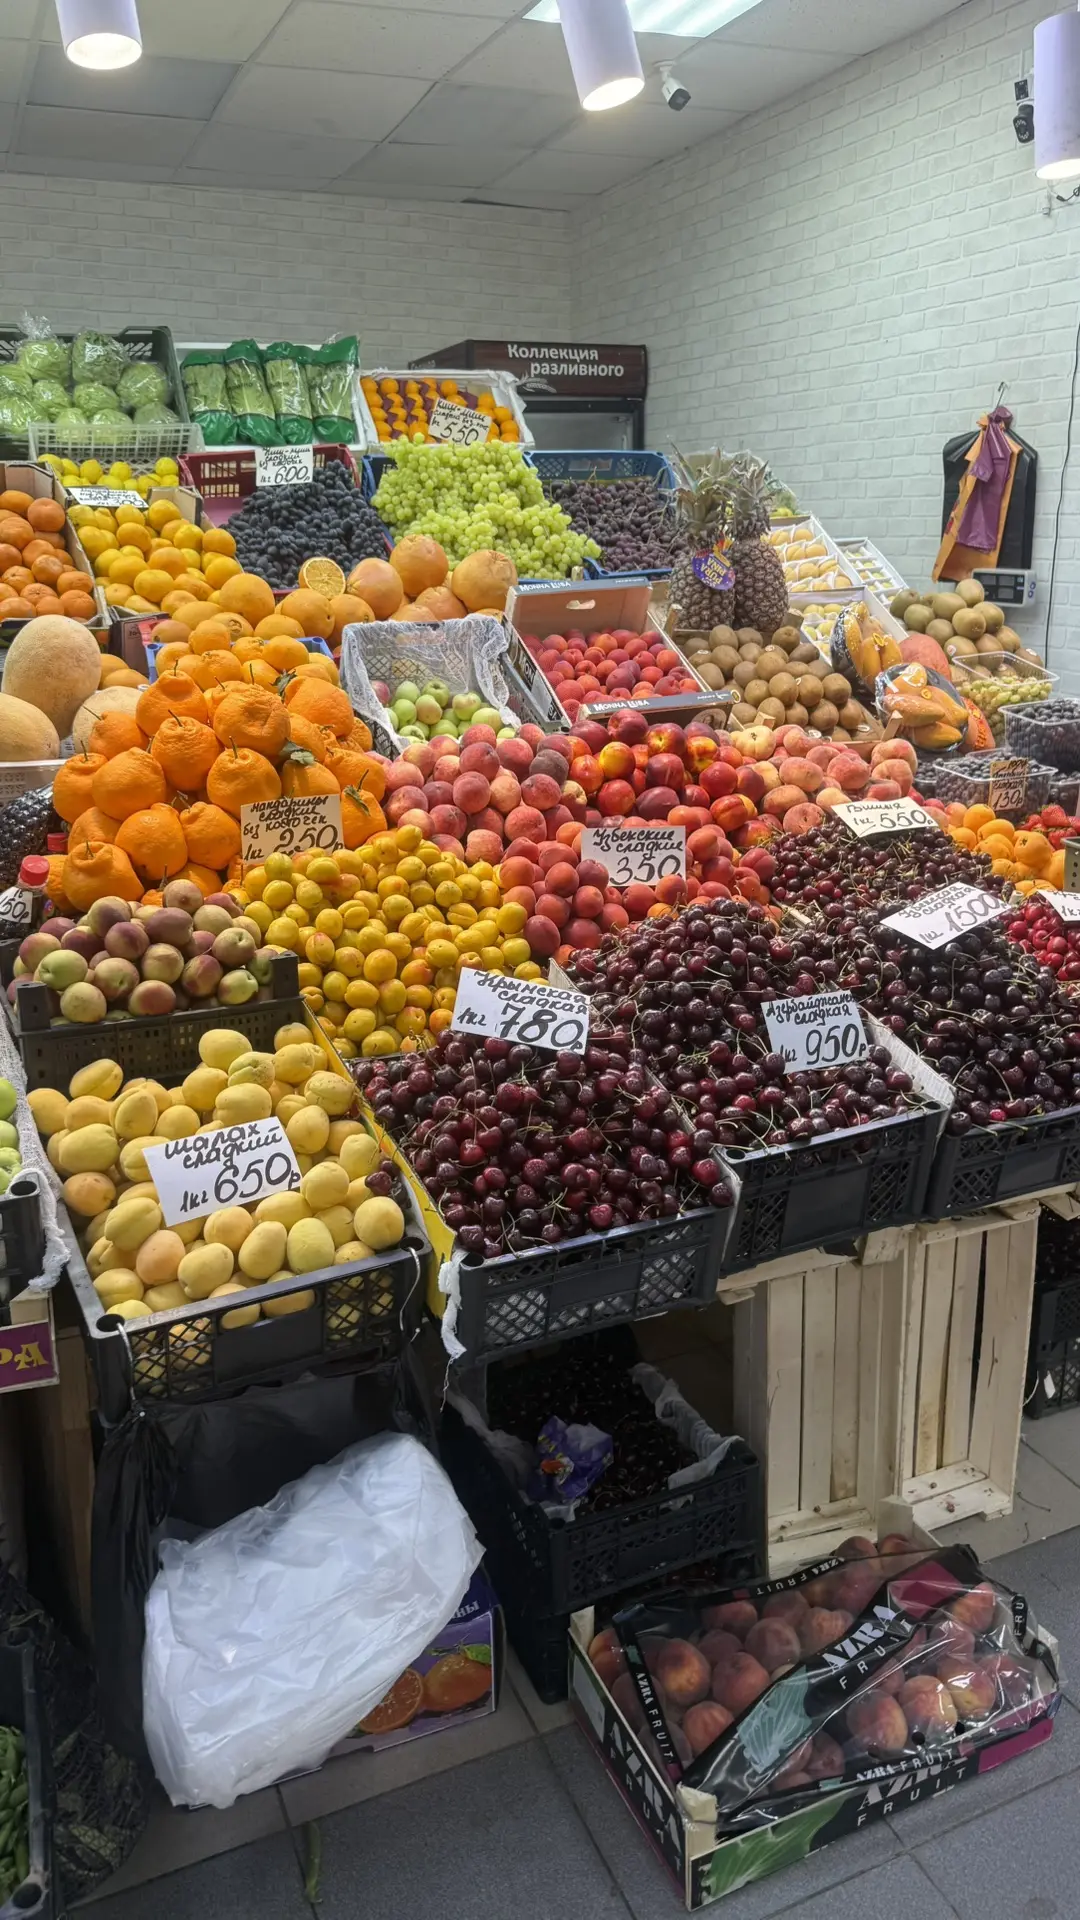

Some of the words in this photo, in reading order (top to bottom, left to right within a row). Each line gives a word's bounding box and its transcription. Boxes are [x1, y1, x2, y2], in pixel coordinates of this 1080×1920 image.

[507, 344, 599, 362] Коллекция
[530, 362, 624, 377] разливного
[440, 421, 479, 446] 550
[243, 822, 260, 839] без
[593, 828, 676, 852] Узбекские
[616, 841, 684, 860] сладкие
[498, 990, 588, 1015] сладкая
[794, 1003, 852, 1026] сладкая
[780, 1044, 797, 1062] 1кг
[180, 1190, 208, 1212] 1кг
[756, 1573, 807, 1595] FRUIT
[822, 1605, 897, 1675] AZRA
[636, 1672, 654, 1705] AZRA
[648, 1708, 674, 1757] FRUIT
[856, 1764, 896, 1781] AZRA
[900, 1748, 953, 1772] FRUIT
[857, 1767, 966, 1827] FRUIT
